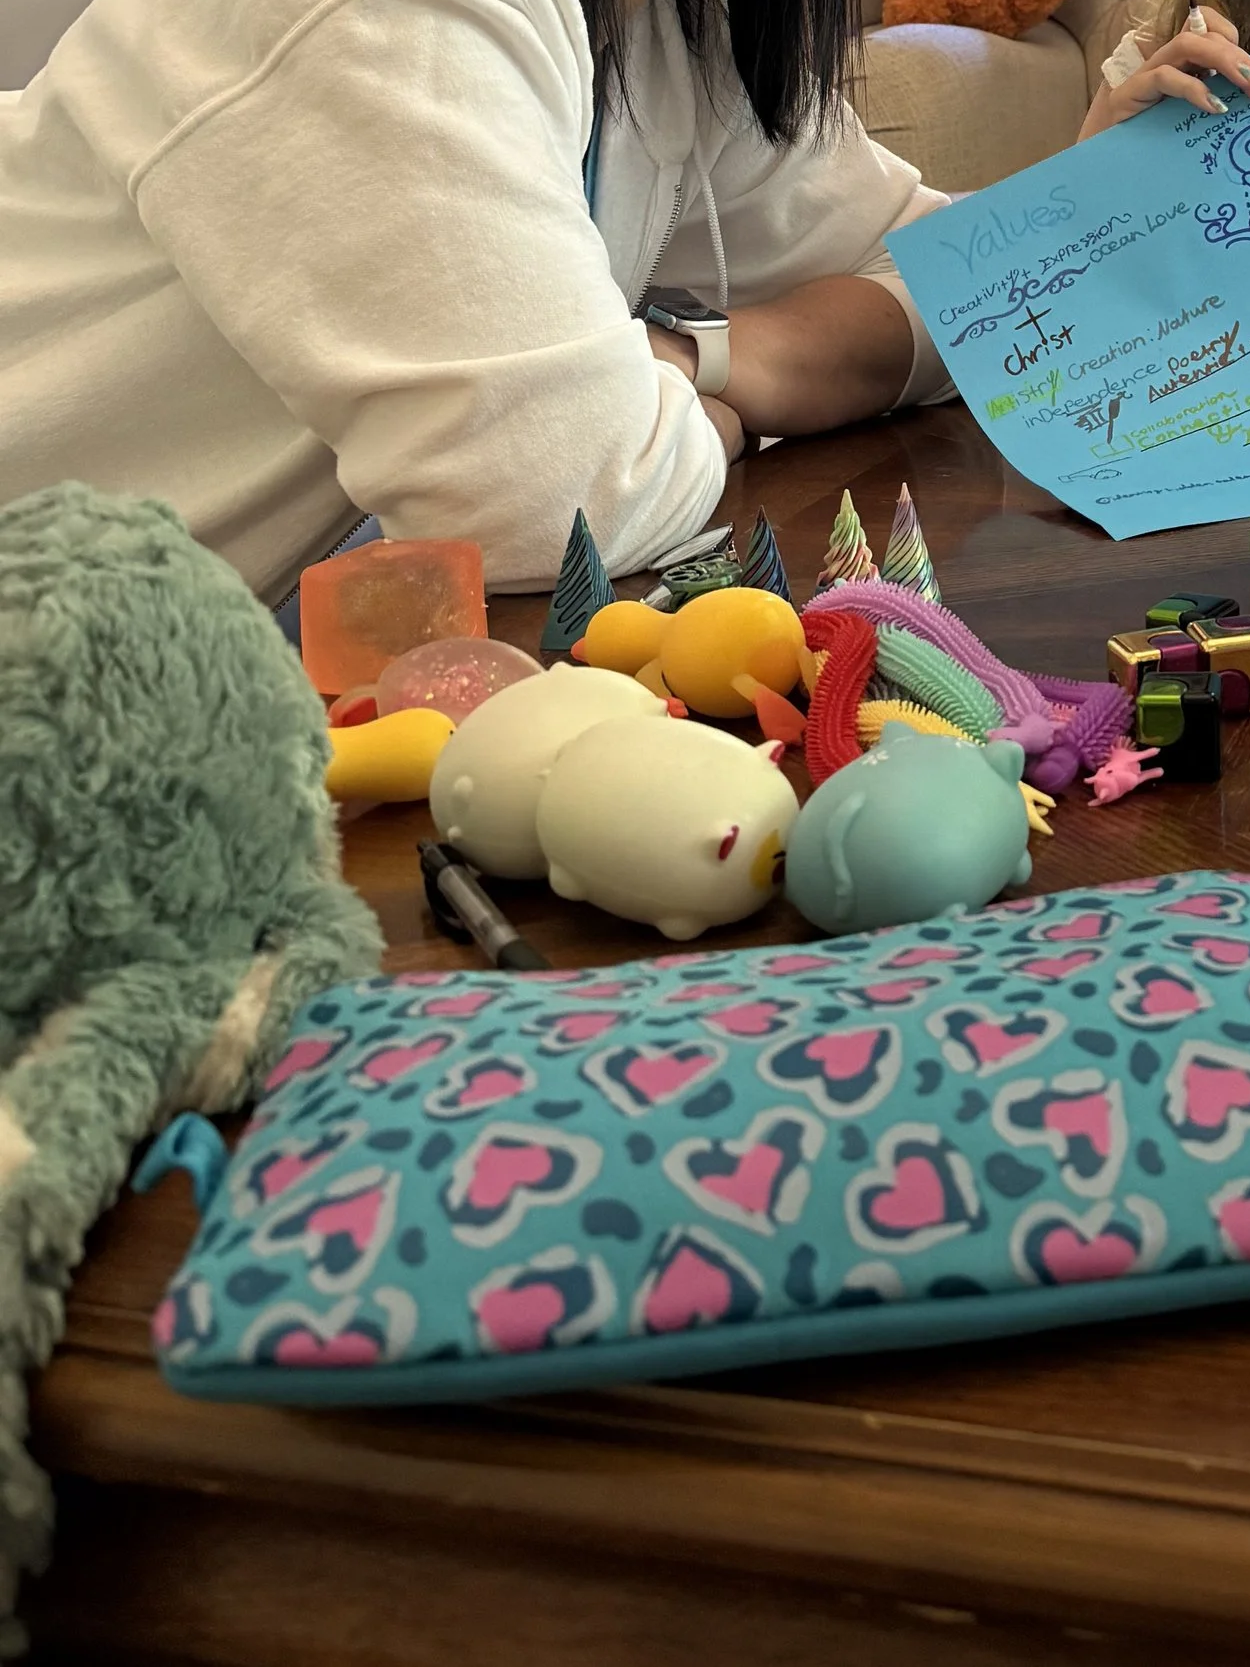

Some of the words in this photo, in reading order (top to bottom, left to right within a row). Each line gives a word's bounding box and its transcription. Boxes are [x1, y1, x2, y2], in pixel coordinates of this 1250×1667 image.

[940, 185, 1076, 275] Values
[1145, 201, 1190, 234] Love
[1038, 213, 1132, 275] Expression
[1157, 295, 1226, 341] Nature
[1003, 325, 1075, 376] Christ
